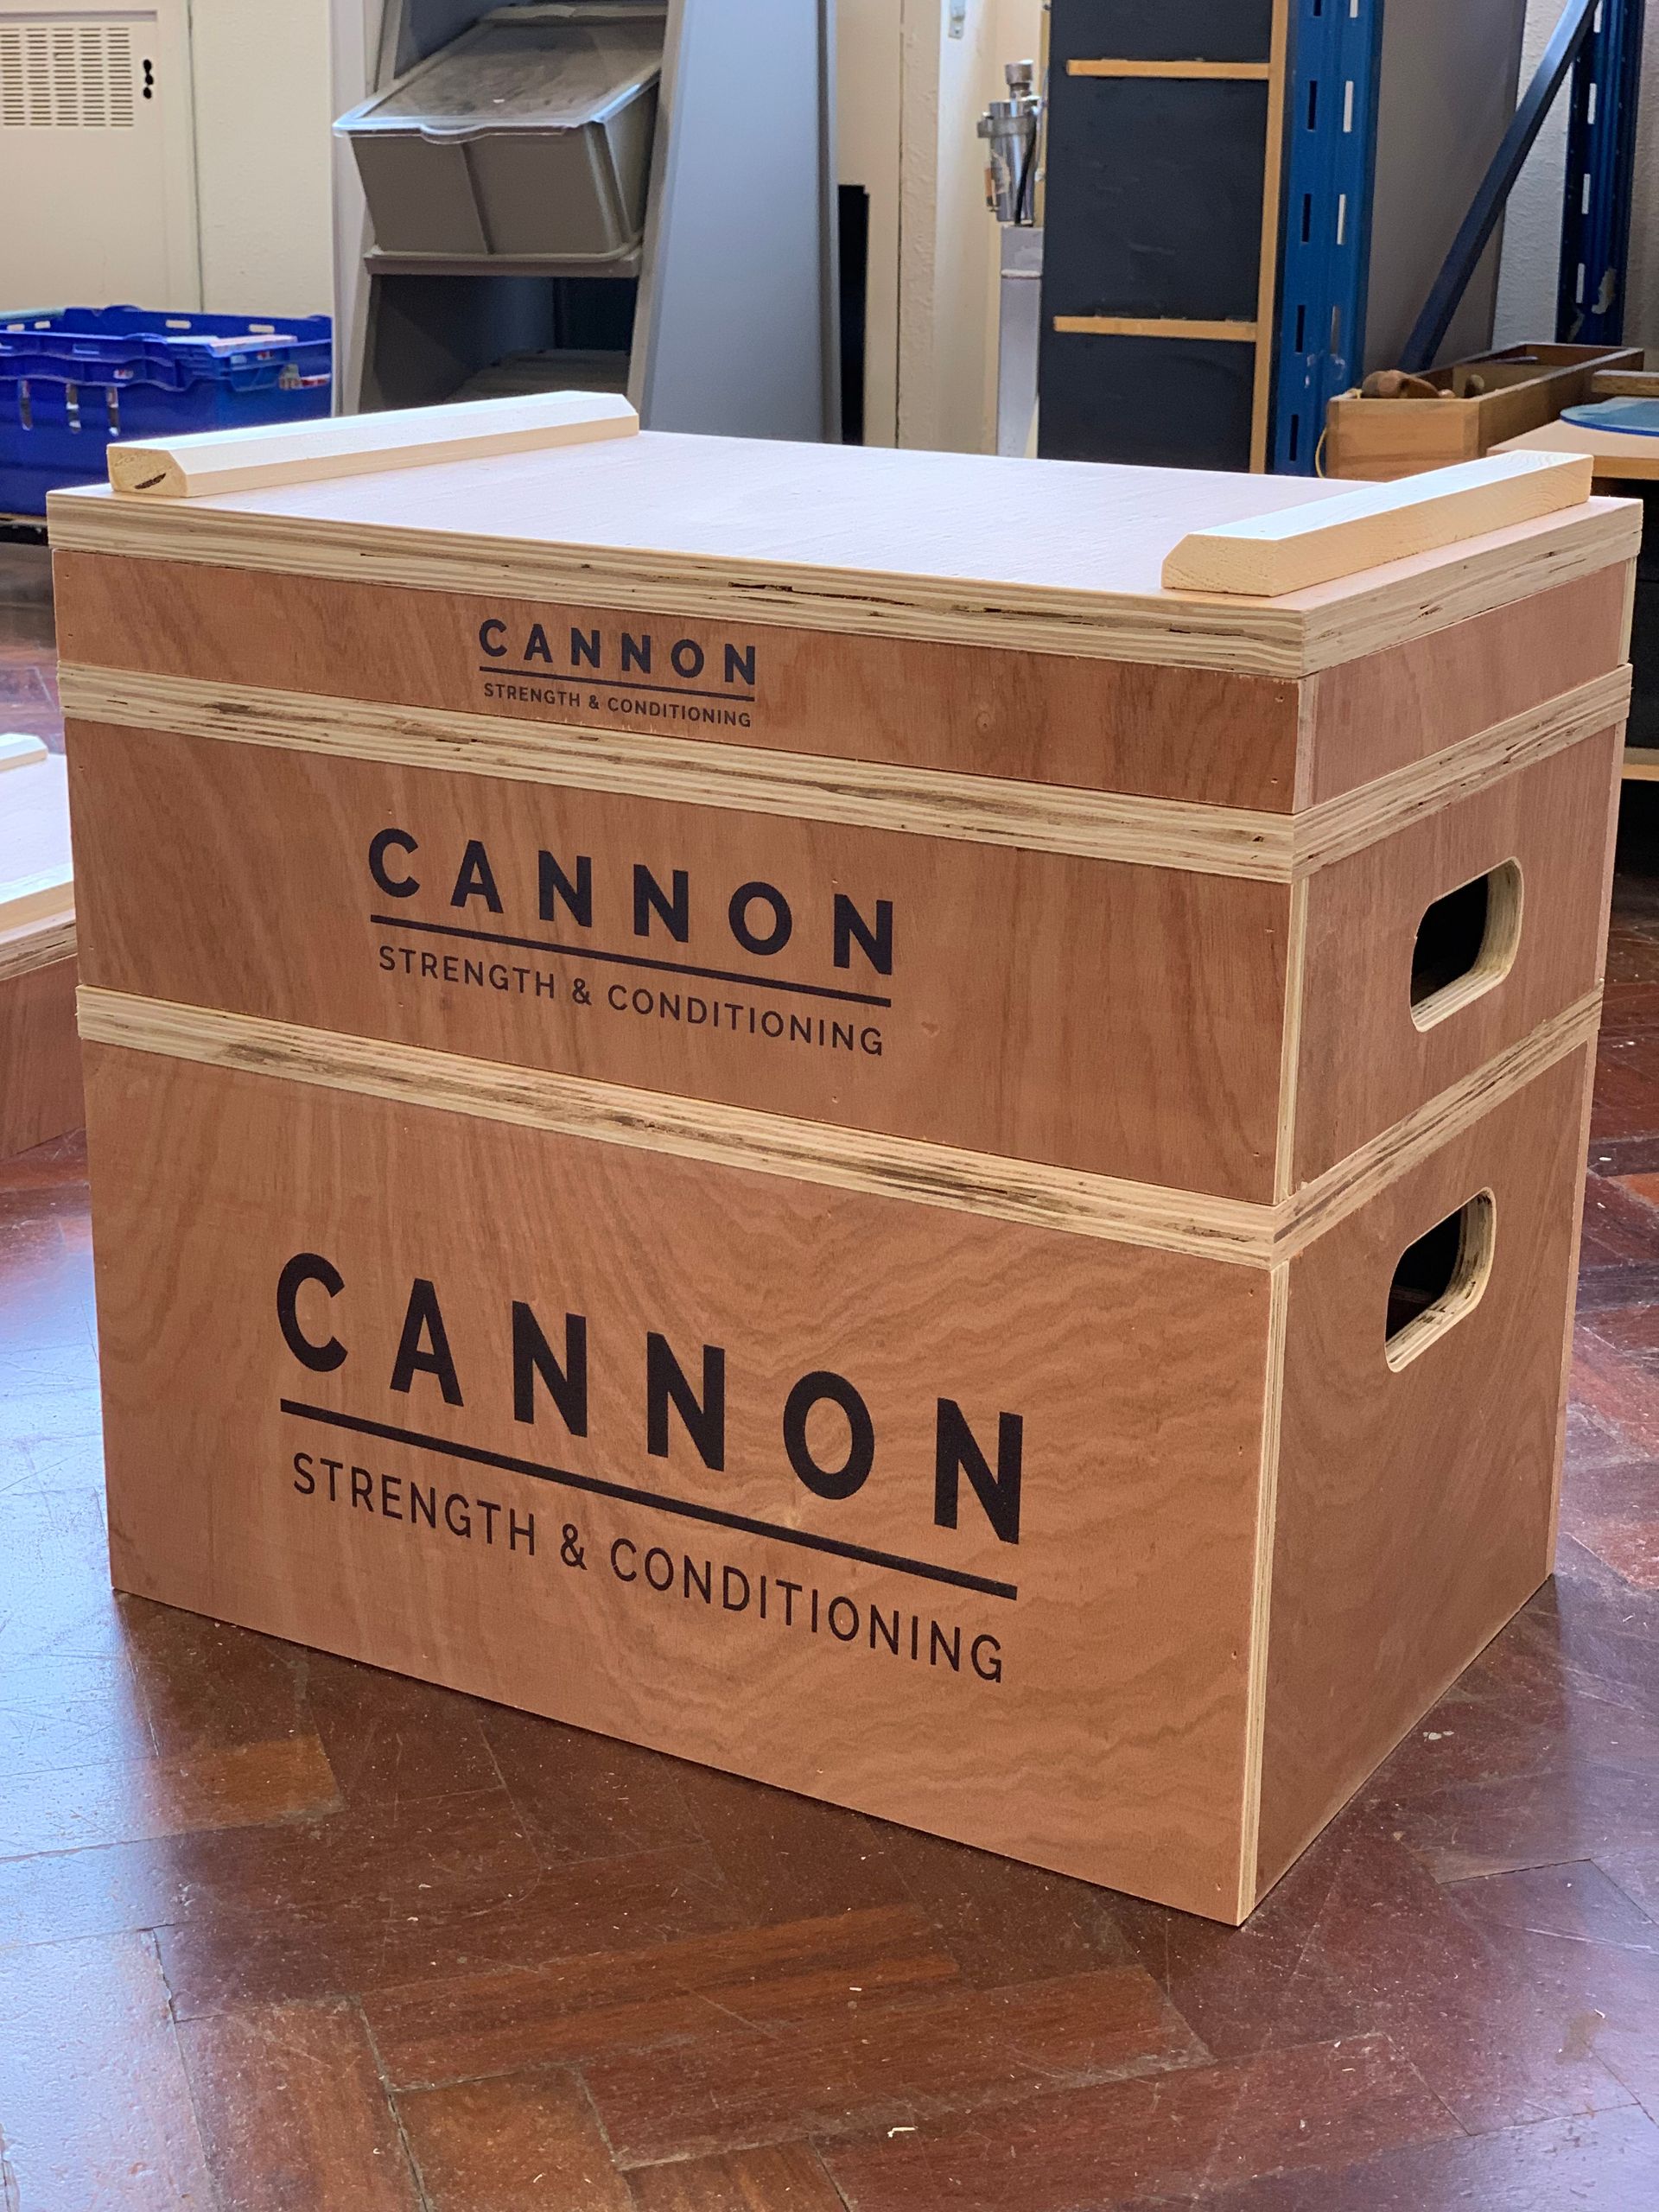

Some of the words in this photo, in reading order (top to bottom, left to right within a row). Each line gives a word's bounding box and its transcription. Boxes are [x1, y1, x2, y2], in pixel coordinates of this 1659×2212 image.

[479, 619, 755, 685] CANNON
[484, 682, 581, 708] STRENGTH
[588, 694, 600, 709] &
[607, 696, 751, 728] CONDITIONING
[369, 827, 893, 976] CANNON
[379, 945, 556, 999] STRENGTH
[571, 977, 592, 1006] &
[607, 984, 882, 1057] CONDITIONING
[276, 1252, 1024, 1545] CANNON
[293, 1452, 535, 1556] STRENGTH
[560, 1523, 588, 1571] &
[610, 1538, 1002, 1683] CONDITIONING
